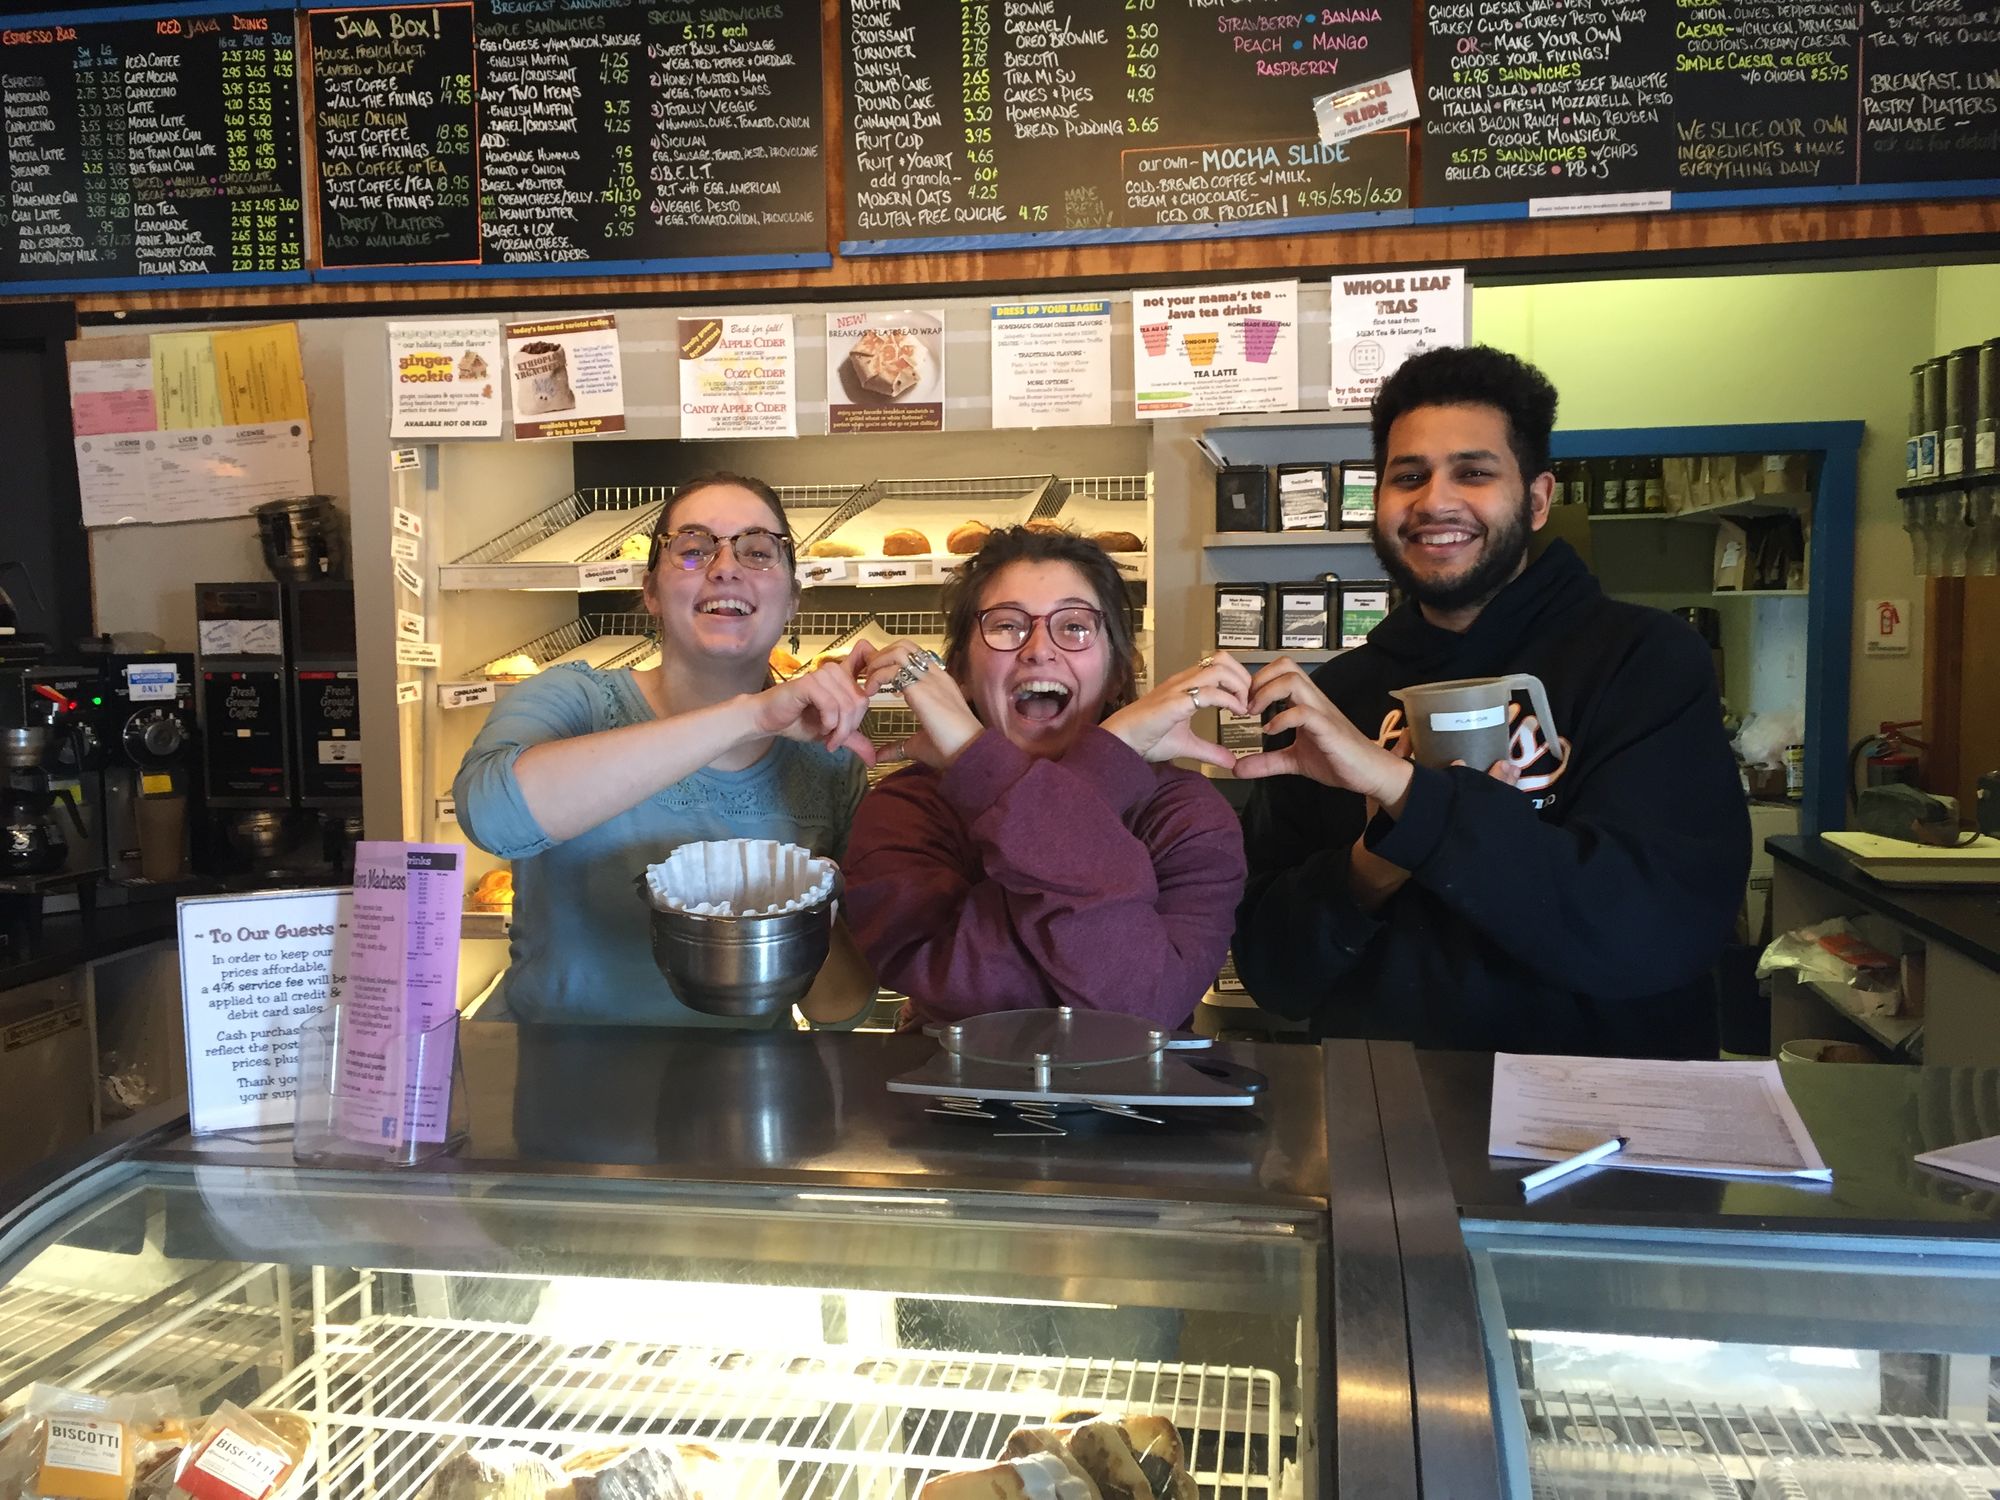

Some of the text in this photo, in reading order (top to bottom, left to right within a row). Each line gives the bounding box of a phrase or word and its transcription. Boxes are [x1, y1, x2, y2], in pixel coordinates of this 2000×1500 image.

[648, 5, 784, 25] SPECIAL SANDWICHES
[851, 6, 988, 28] SCONE 2.75
[1217, 8, 1382, 33] STRAWBERRY BANANA
[2, 26, 77, 46] ESPRESSO BAR
[156, 16, 268, 38] ICED JAVA DRINKS
[335, 16, 381, 39] JAVA
[683, 24, 748, 40] 5.75 each
[851, 21, 991, 45] CROISSANT 2.50
[1233, 33, 1368, 53] PEACH MANGO
[1457, 26, 1622, 54] OR MAKE YOUR OWN
[126, 50, 292, 68] ICED COFFEE 2.35 2.95 3.60
[1004, 44, 1159, 67] BISCOTTI 2.60
[1451, 54, 1501, 69] CHOOSE
[1506, 52, 1542, 66] YOUR
[1675, 53, 1725, 72] SIMPLE
[1728, 52, 1777, 70] CAESAR
[1796, 50, 1835, 66] GREEK
[1256, 58, 1339, 77] RASPBERRY
[1453, 62, 1581, 84] $7.95 SANDWICHES
[1810, 64, 1849, 81] $5.95
[319, 112, 408, 127] SINGLE ORIGIN
[854, 107, 993, 130] CINNAMON BUN 3.50
[1344, 101, 1389, 126] SLIDE
[1676, 114, 1849, 141] WE SLICE OUR OWN
[1866, 116, 1946, 133] AVAILABLE
[326, 125, 468, 144] JUST COFFEE 18.95
[855, 128, 991, 151] FRUIT CUP 3.95
[1488, 127, 1621, 148] CROQUE MONSIEUR
[1139, 158, 1162, 173] our
[1202, 147, 1280, 173] MOCHA
[1287, 140, 1350, 166] SLIDE
[1677, 140, 1845, 160] INGREDIENTS MAKE
[1679, 159, 1821, 178] EVERYTHING DAILY
[858, 185, 998, 207] MODERN OATS 4.25
[858, 205, 1049, 229] GLUTEN-FREE QUICHE 4.75
[1156, 208, 1187, 224] ICED
[1192, 206, 1213, 221] OR
[138, 258, 300, 274] ITALIAN SODA 3.25
[1343, 276, 1451, 295] WHOLE LEAF
[1143, 290, 1271, 309] not your mama's tea
[1375, 298, 1418, 315] TEAS
[997, 306, 1025, 316] DRESS
[1027, 306, 1039, 314] UP
[1041, 305, 1068, 313] YOUR
[1167, 303, 1262, 320] Java tea drinks
[731, 324, 750, 333] Back
[752, 324, 763, 334] for
[836, 314, 868, 328] NEW!
[829, 329, 872, 337] BREAKFAST
[920, 327, 942, 336] WRAP
[719, 337, 786, 349] APPLE CIDER
[399, 354, 453, 368] ginger
[400, 370, 453, 383] cookie
[724, 367, 786, 379] COZY CIDER
[1194, 369, 1238, 378] TEA LATTE
[682, 403, 787, 414] CANDY APPLE CIDER
[229, 685, 257, 697] Fresh
[226, 696, 260, 709] Ground
[228, 707, 259, 720] Coffee
[209, 923, 334, 944] To Our Guests
[212, 949, 333, 965] In order to keep our
[221, 962, 326, 981] prices affordable,
[201, 986, 209, 994] a
[238, 979, 283, 992] service
[285, 978, 304, 989] fee
[307, 975, 330, 987] will
[332, 973, 347, 985] be
[209, 988, 342, 1009] applied to all credit &
[227, 1008, 260, 1021] debit
[262, 1006, 290, 1018] card
[216, 1029, 248, 1042] Cash
[205, 1043, 270, 1057] reflect the
[237, 1077, 279, 1088] Thank
[52, 1426, 120, 1449] BISCOTTI
